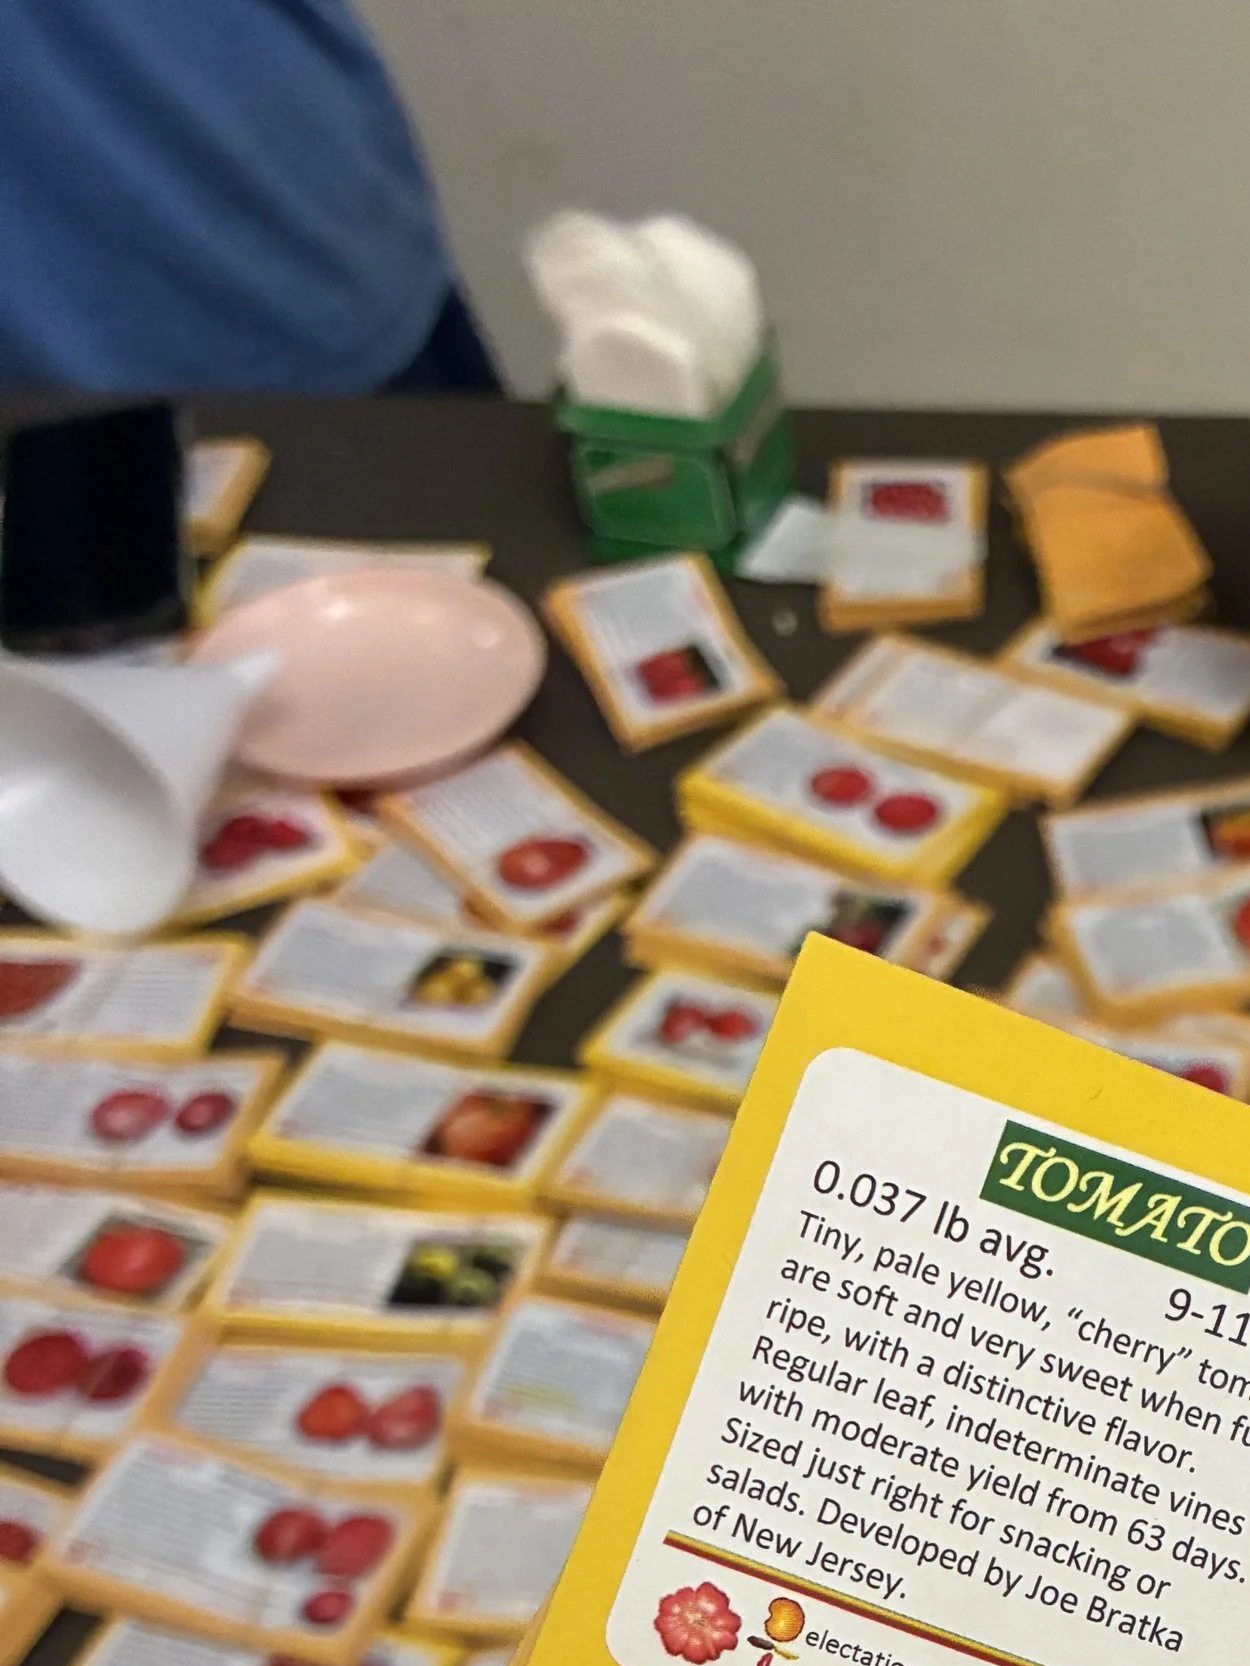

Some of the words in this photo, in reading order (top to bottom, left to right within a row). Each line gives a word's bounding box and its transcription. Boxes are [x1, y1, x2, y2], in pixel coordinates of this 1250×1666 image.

[800, 1209, 864, 1264] Tiny,
[872, 1246, 940, 1286] pale
[946, 1271, 1051, 1332] yellow,
[813, 1160, 927, 1223] 0.037
[932, 1200, 970, 1243] lb
[979, 1228, 1053, 1280] avg.
[752, 1335, 869, 1397] Regular
[872, 1377, 937, 1429] leaf,
[945, 1404, 1161, 1506] indeterminate
[1170, 1491, 1246, 1536] vines
[766, 1297, 831, 1345] ripe,
[844, 1326, 909, 1368] with
[916, 1355, 935, 1378] a
[943, 1360, 1097, 1436] distinctive
[1104, 1415, 1195, 1474] flavor.
[780, 1259, 831, 1292] are
[836, 1279, 899, 1317] soft
[903, 1303, 965, 1340] and
[971, 1325, 1036, 1371] very
[1039, 1353, 1134, 1403] sweet
[1140, 1387, 1222, 1435] when
[692, 1504, 731, 1531] of
[732, 1514, 802, 1559] New
[804, 1540, 907, 1601] Jersey.
[706, 1464, 805, 1516] salads.
[816, 1497, 980, 1578] Developed
[983, 1556, 1023, 1598] by
[1024, 1574, 1079, 1614] Joe
[1085, 1595, 1184, 1653] Bratka
[720, 1417, 804, 1467] Sized
[802, 1447, 866, 1491] just
[870, 1474, 944, 1519] right
[949, 1498, 996, 1536] for
[998, 1524, 1132, 1592] snacking
[1136, 1573, 1172, 1600] or
[739, 1381, 804, 1422] with
[810, 1408, 960, 1478] moderate
[966, 1464, 1041, 1507] yield
[1045, 1486, 1118, 1536] from
[1127, 1518, 1166, 1552] 63
[1171, 1535, 1245, 1584] days.
